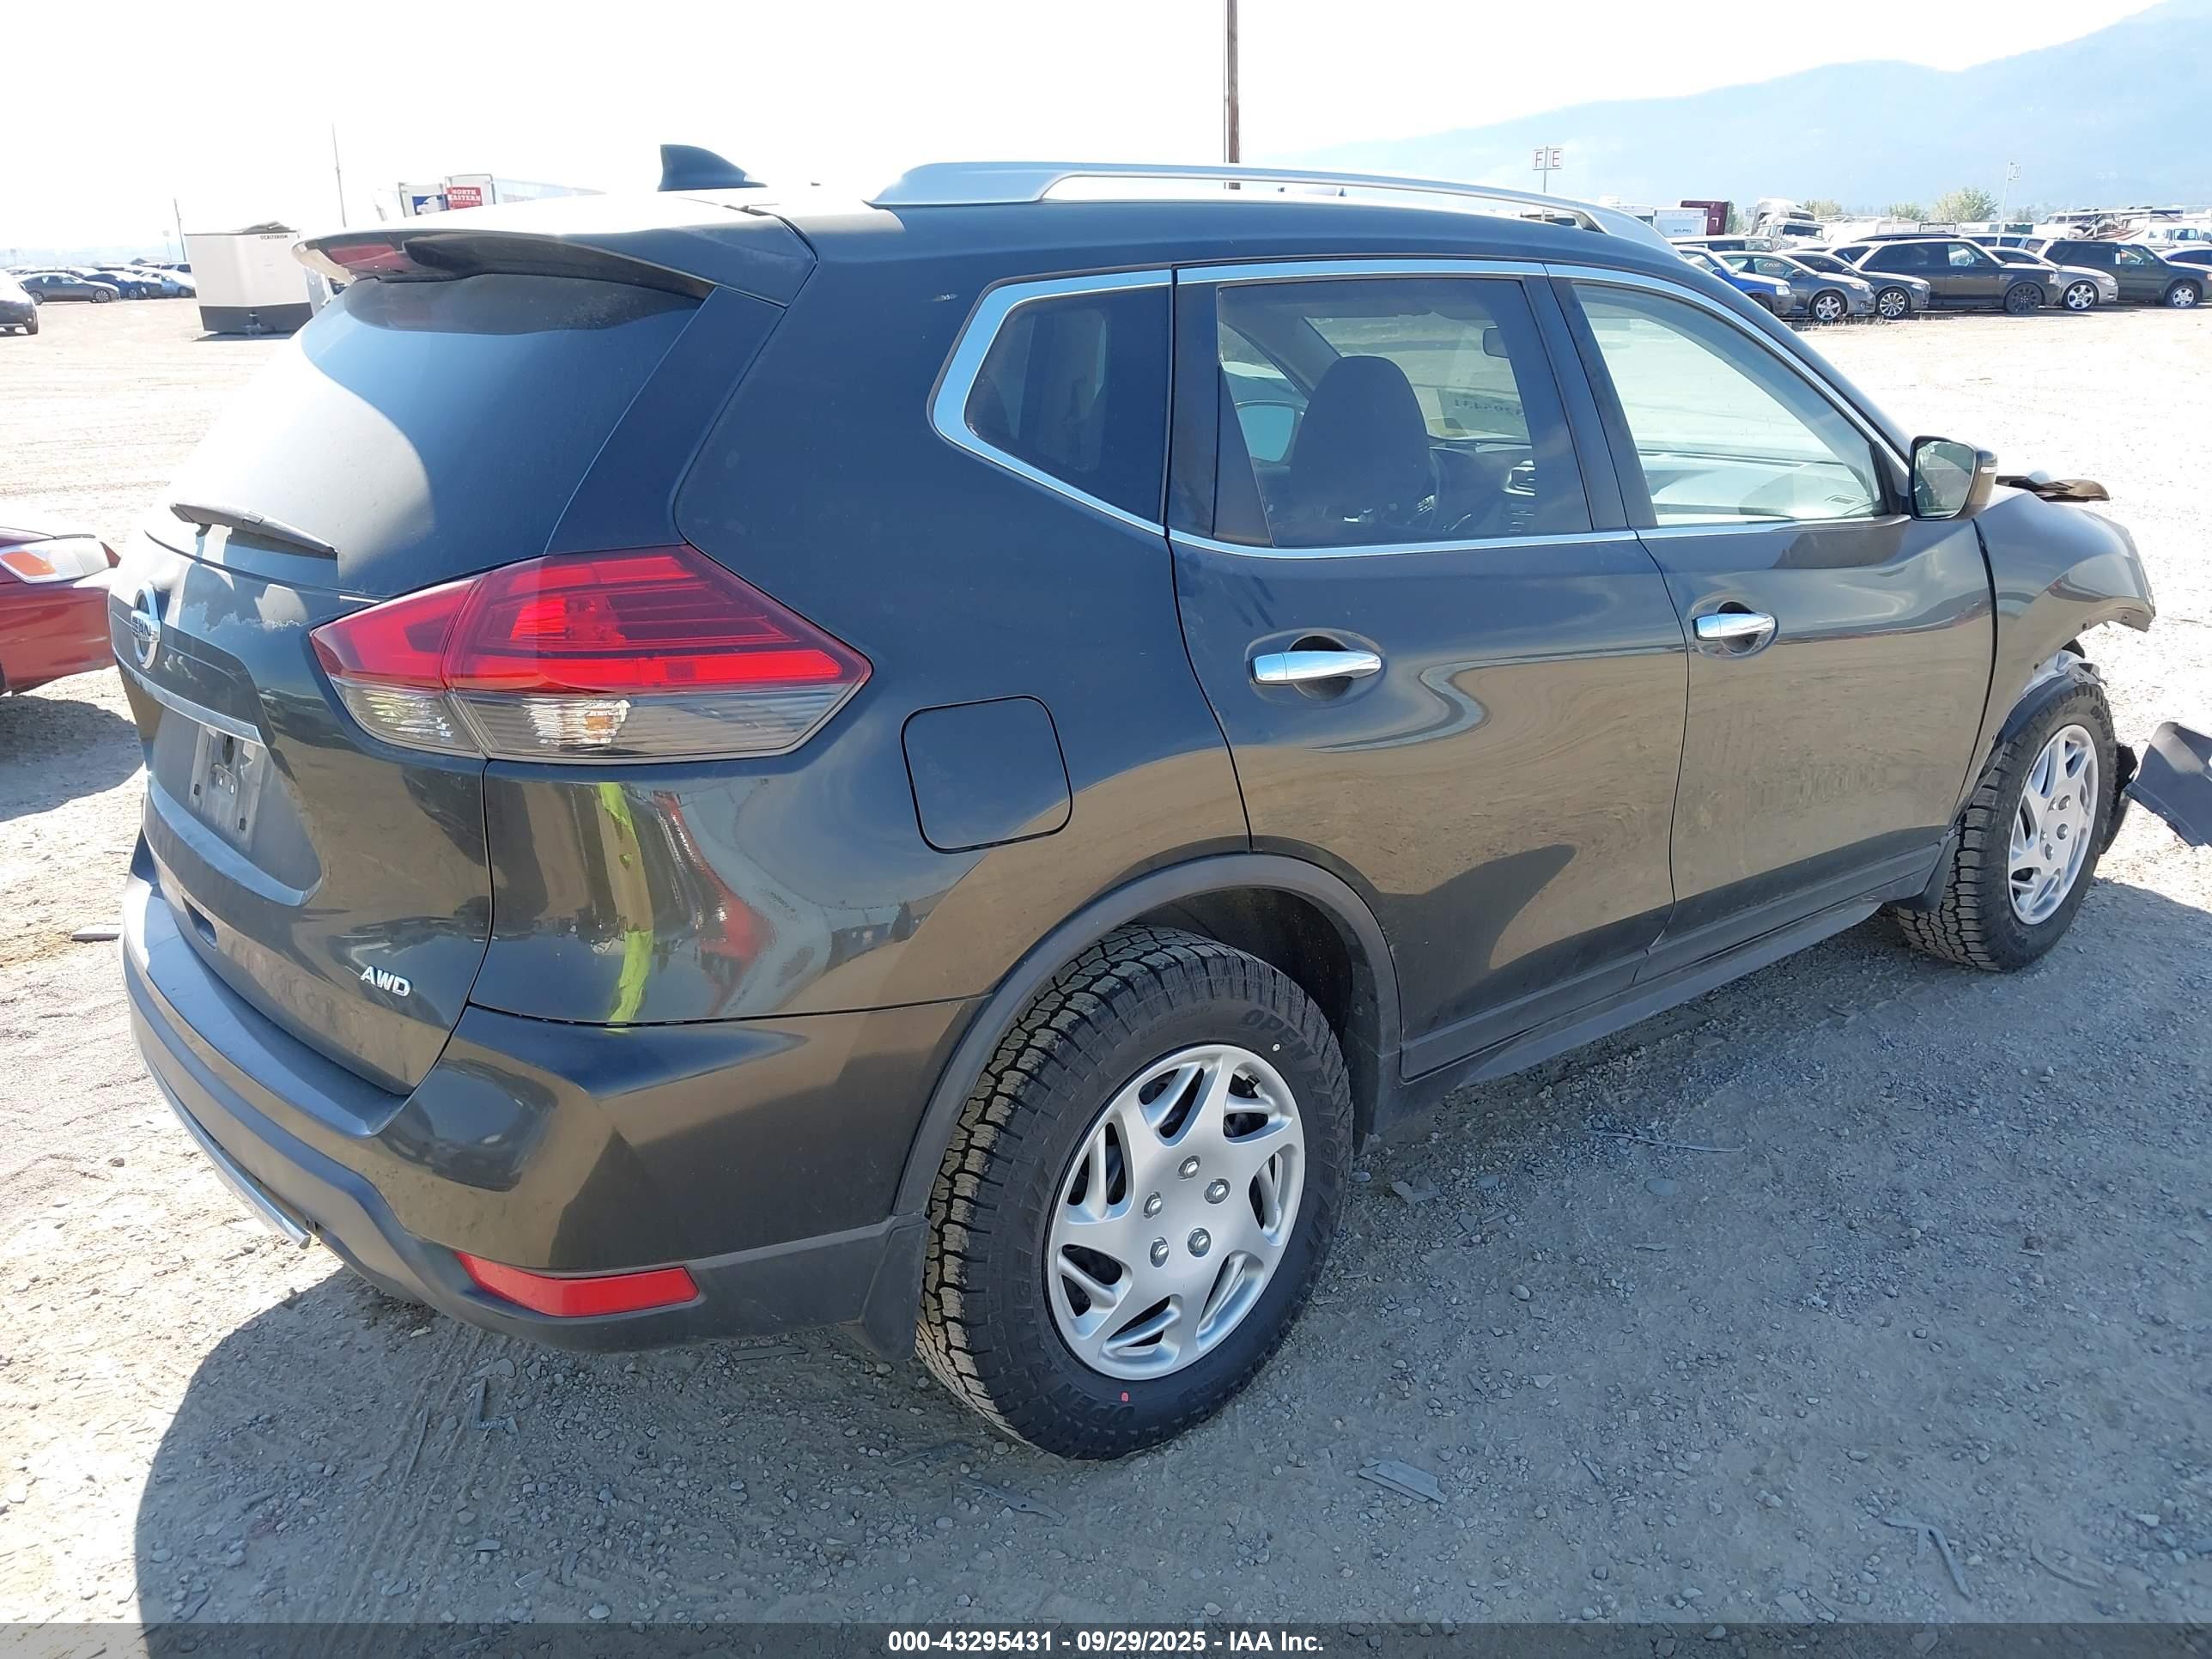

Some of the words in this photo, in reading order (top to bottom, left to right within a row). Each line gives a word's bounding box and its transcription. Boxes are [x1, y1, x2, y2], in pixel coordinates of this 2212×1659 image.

[1535, 152, 1544, 167] F
[1553, 151, 1560, 167] E
[361, 966, 410, 997] AWD
[1241, 1007, 1313, 1065] OPEN
